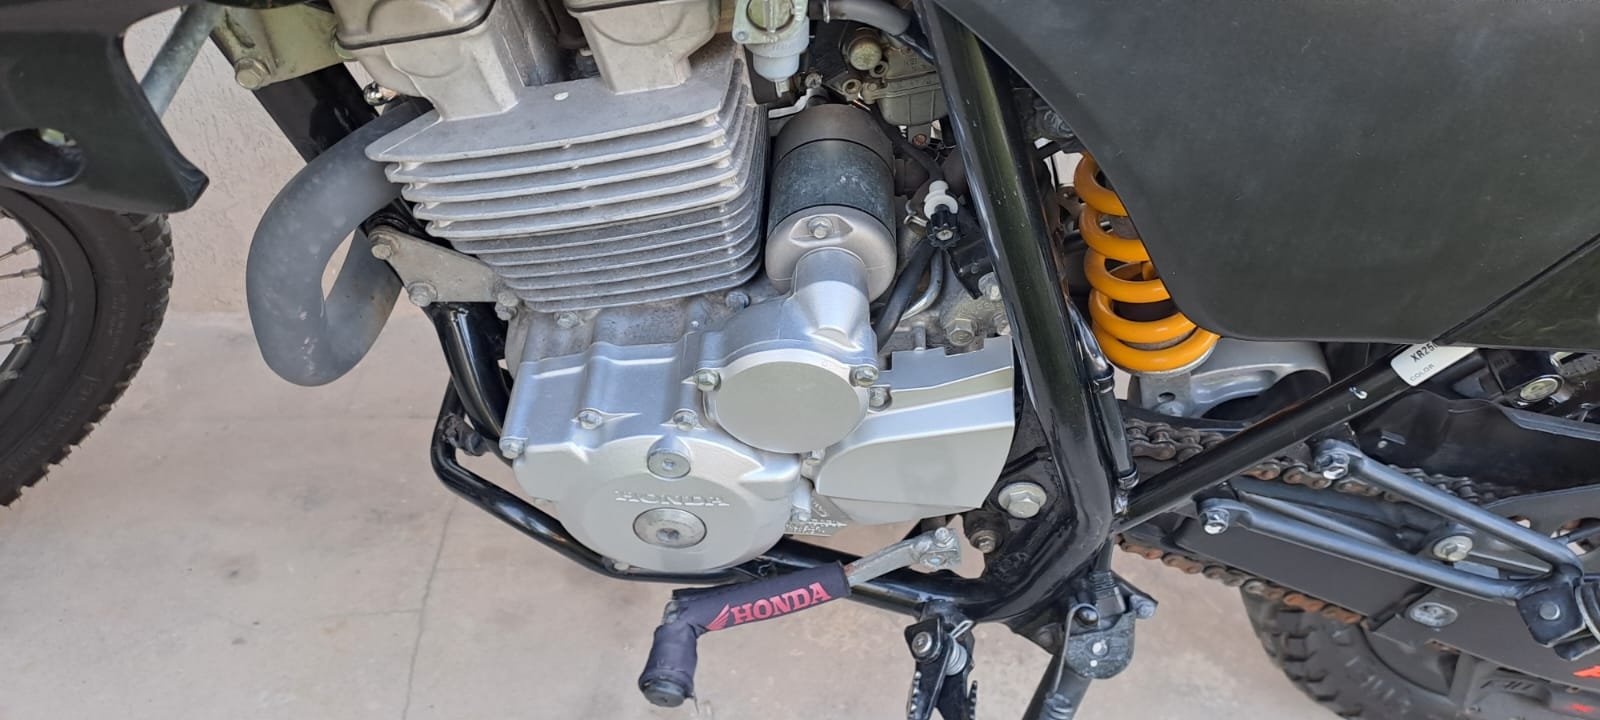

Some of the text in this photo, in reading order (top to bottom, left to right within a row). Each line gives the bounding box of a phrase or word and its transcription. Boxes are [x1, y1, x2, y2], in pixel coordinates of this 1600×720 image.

[1410, 363, 1435, 381] COLOR
[615, 490, 730, 507] HONDA
[730, 582, 832, 624] HONDA
